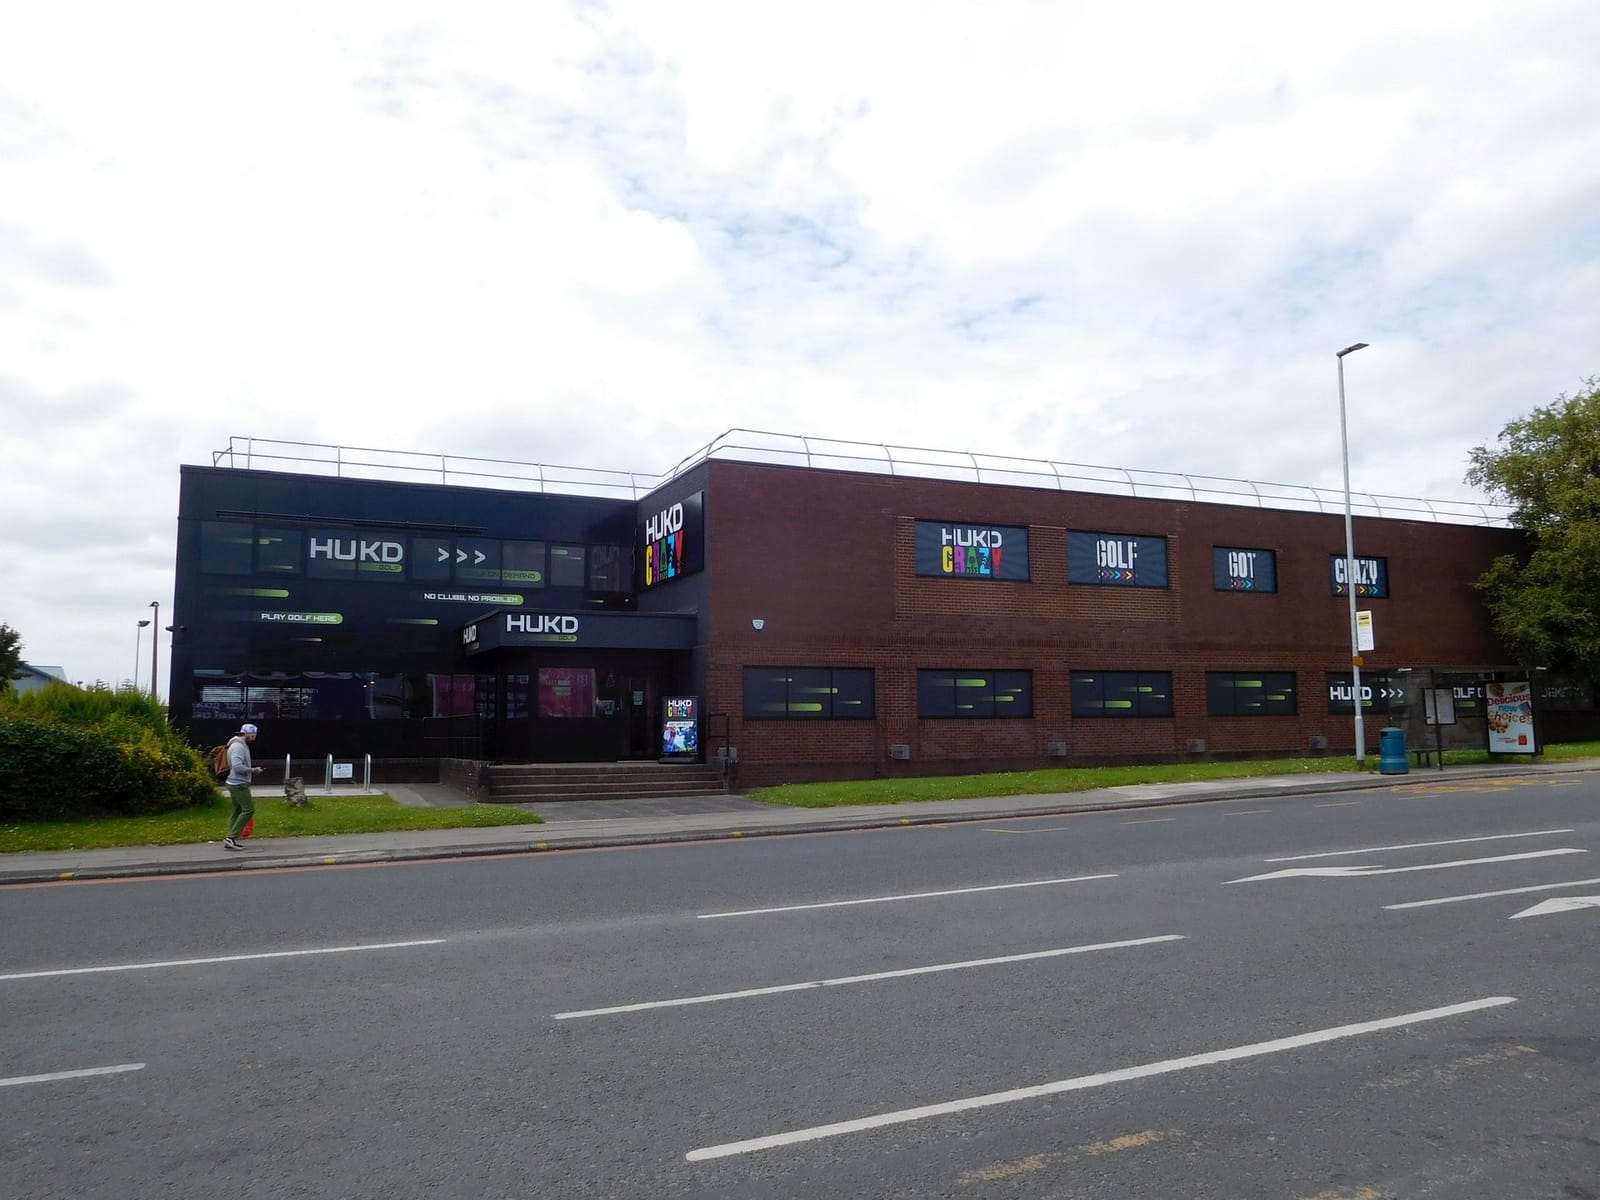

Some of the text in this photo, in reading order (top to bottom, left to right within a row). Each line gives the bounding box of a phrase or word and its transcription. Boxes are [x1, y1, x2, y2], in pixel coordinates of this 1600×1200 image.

[646, 503, 683, 545] HUKD
[942, 528, 1002, 548] HUKD
[310, 538, 403, 562] HUKD
[646, 531, 684, 585] CRAZY
[1096, 540, 1137, 569] GOLF
[942, 546, 1003, 576] CRAZY
[1229, 552, 1256, 578] GOT
[506, 614, 579, 633] HUKD
[667, 699, 692, 707] HUKD
[1453, 687, 1475, 699] OLF
[1487, 693, 1532, 706] Delicious
[1489, 710, 1533, 725] choices
[1498, 704, 1518, 712] new
